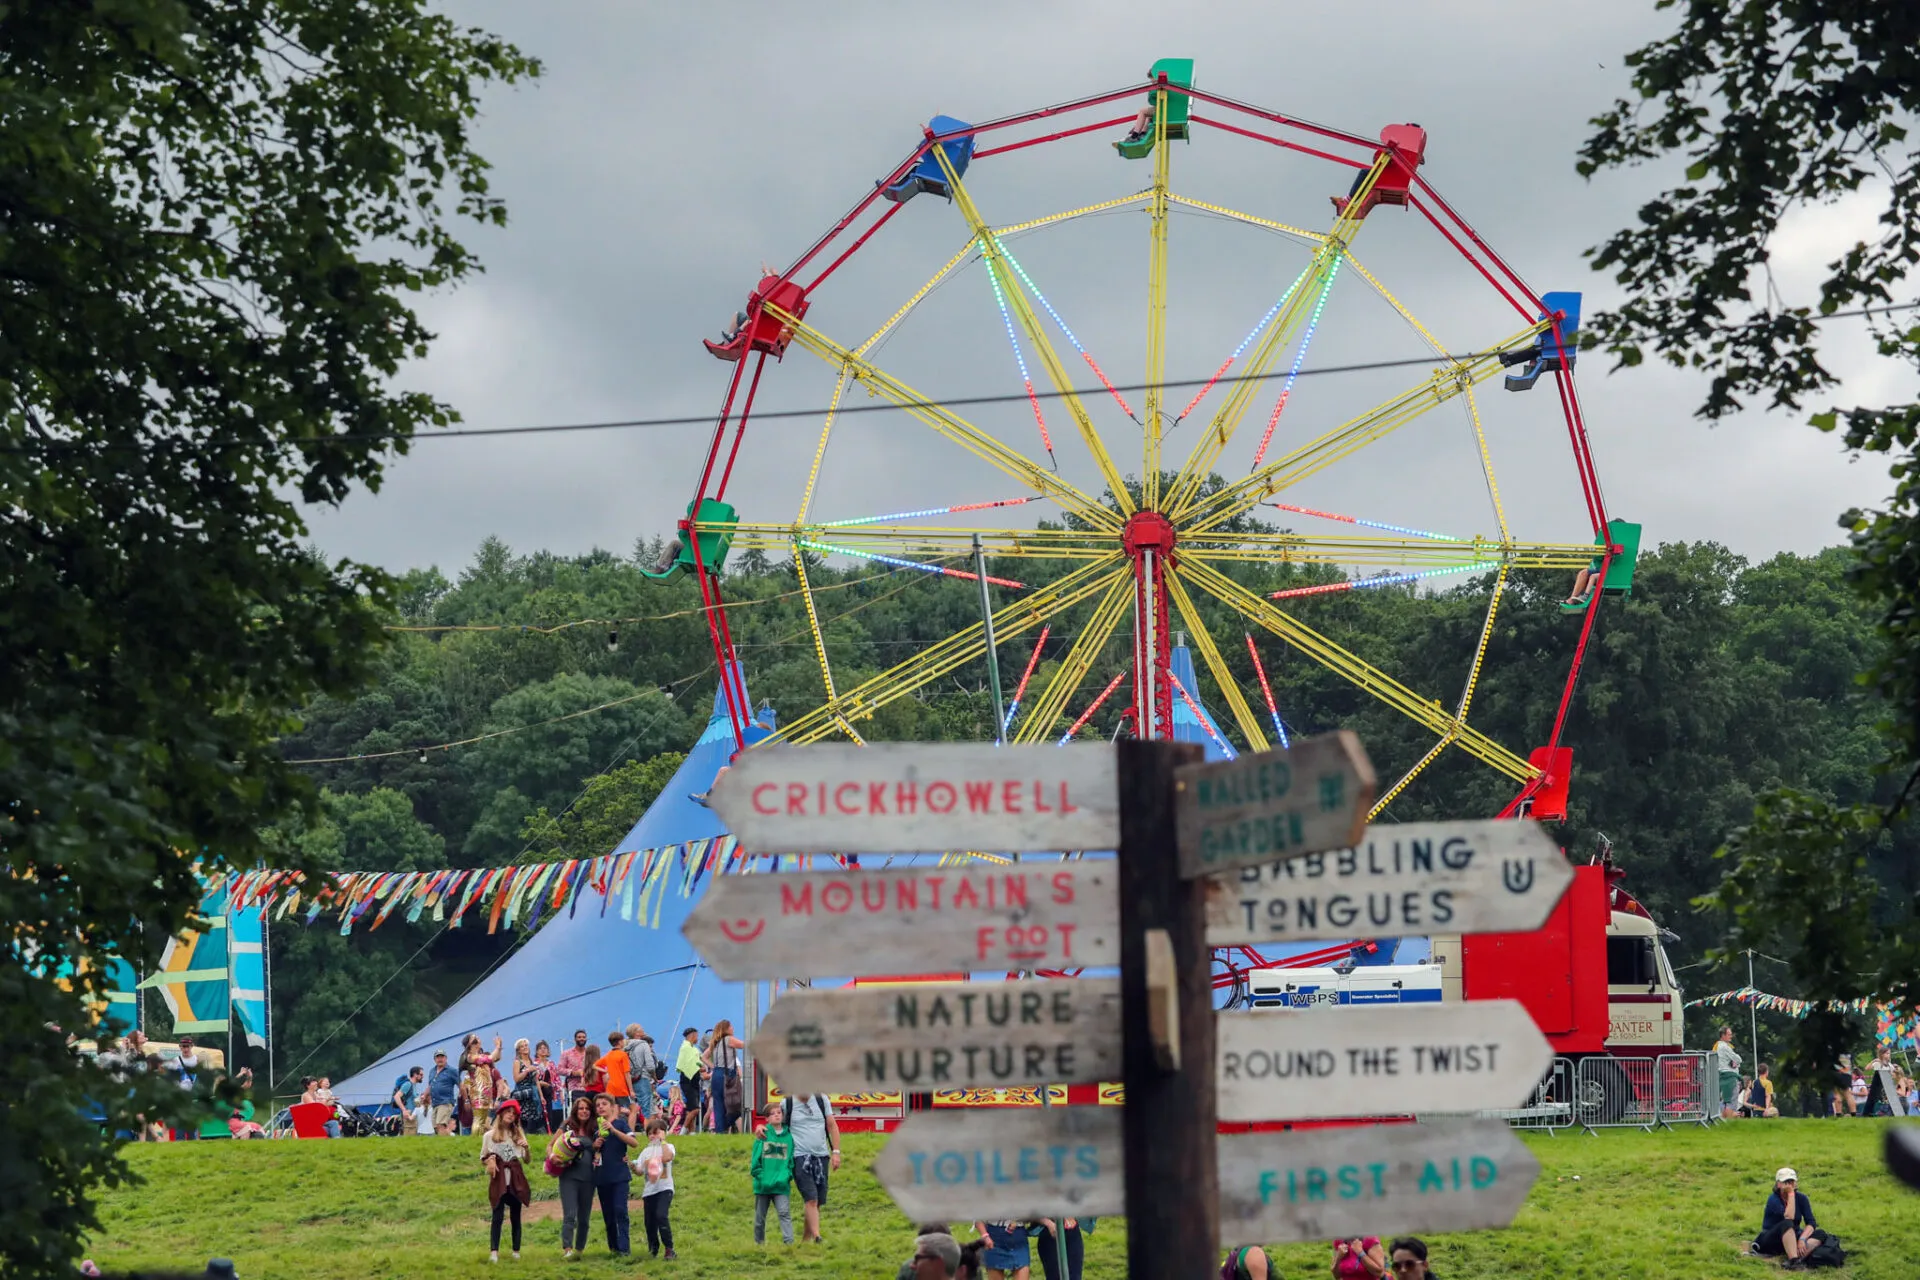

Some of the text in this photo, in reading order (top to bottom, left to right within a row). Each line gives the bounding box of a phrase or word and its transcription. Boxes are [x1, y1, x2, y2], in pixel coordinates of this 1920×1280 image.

[752, 780, 1078, 815] CRICKHOWELL
[1202, 811, 1303, 863] GARDEN
[781, 871, 1076, 915] MOUNTAIN'S
[1240, 890, 1455, 932] TONGUES
[977, 924, 1077, 960] FOOT
[895, 990, 1073, 1027] NATURE
[1291, 993, 1338, 1004] WBPS
[864, 1043, 1076, 1083] NURTURE
[1223, 1043, 1499, 1081] ROUND THE TWIST
[907, 1144, 1101, 1186] TOILETS
[1258, 1155, 1498, 1204] FIRST AID
